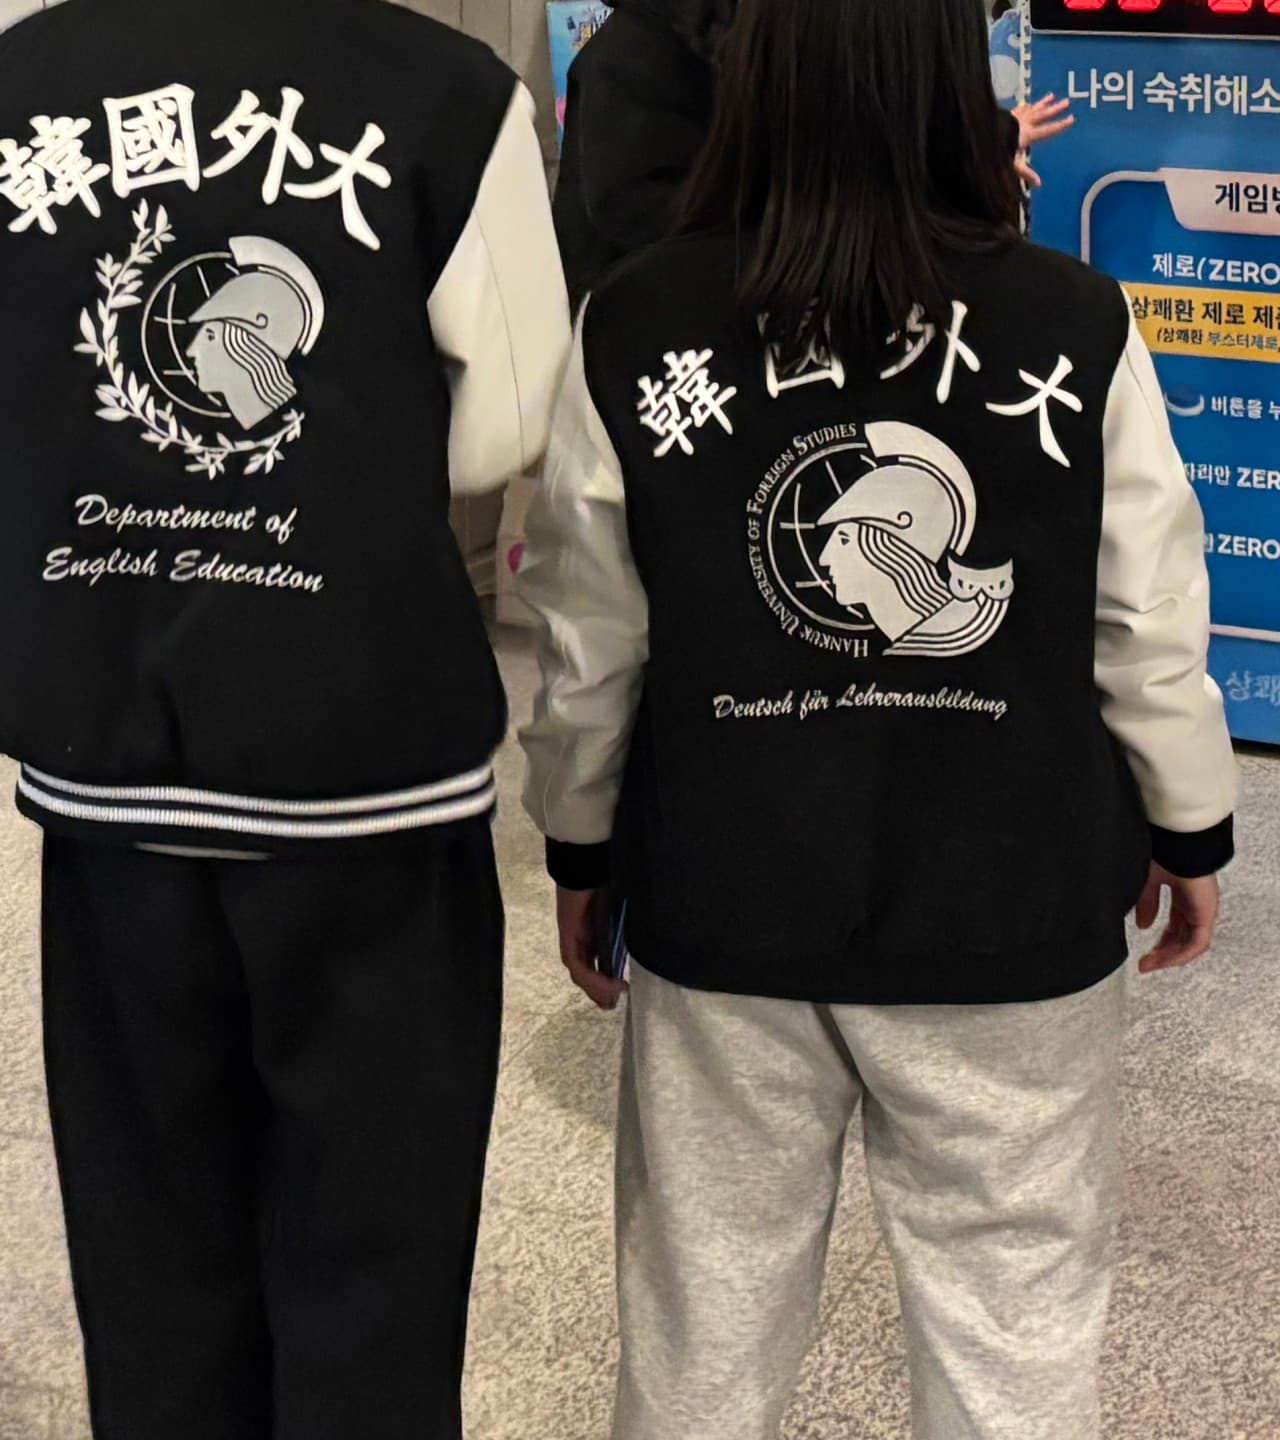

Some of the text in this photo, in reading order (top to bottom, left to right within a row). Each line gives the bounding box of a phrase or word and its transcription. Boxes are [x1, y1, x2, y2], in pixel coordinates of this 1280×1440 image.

[1067, 68, 1134, 110] 나의
[1131, 296, 1194, 323] 상쾌환
[1201, 301, 1246, 326] 제로
[746, 448, 796, 515] FOREIGN
[792, 423, 857, 457] STUDIES
[75, 494, 299, 545] Department of
[42, 547, 325, 593] English Education
[713, 682, 1008, 721] Deutsch für Lehrerausbildung
